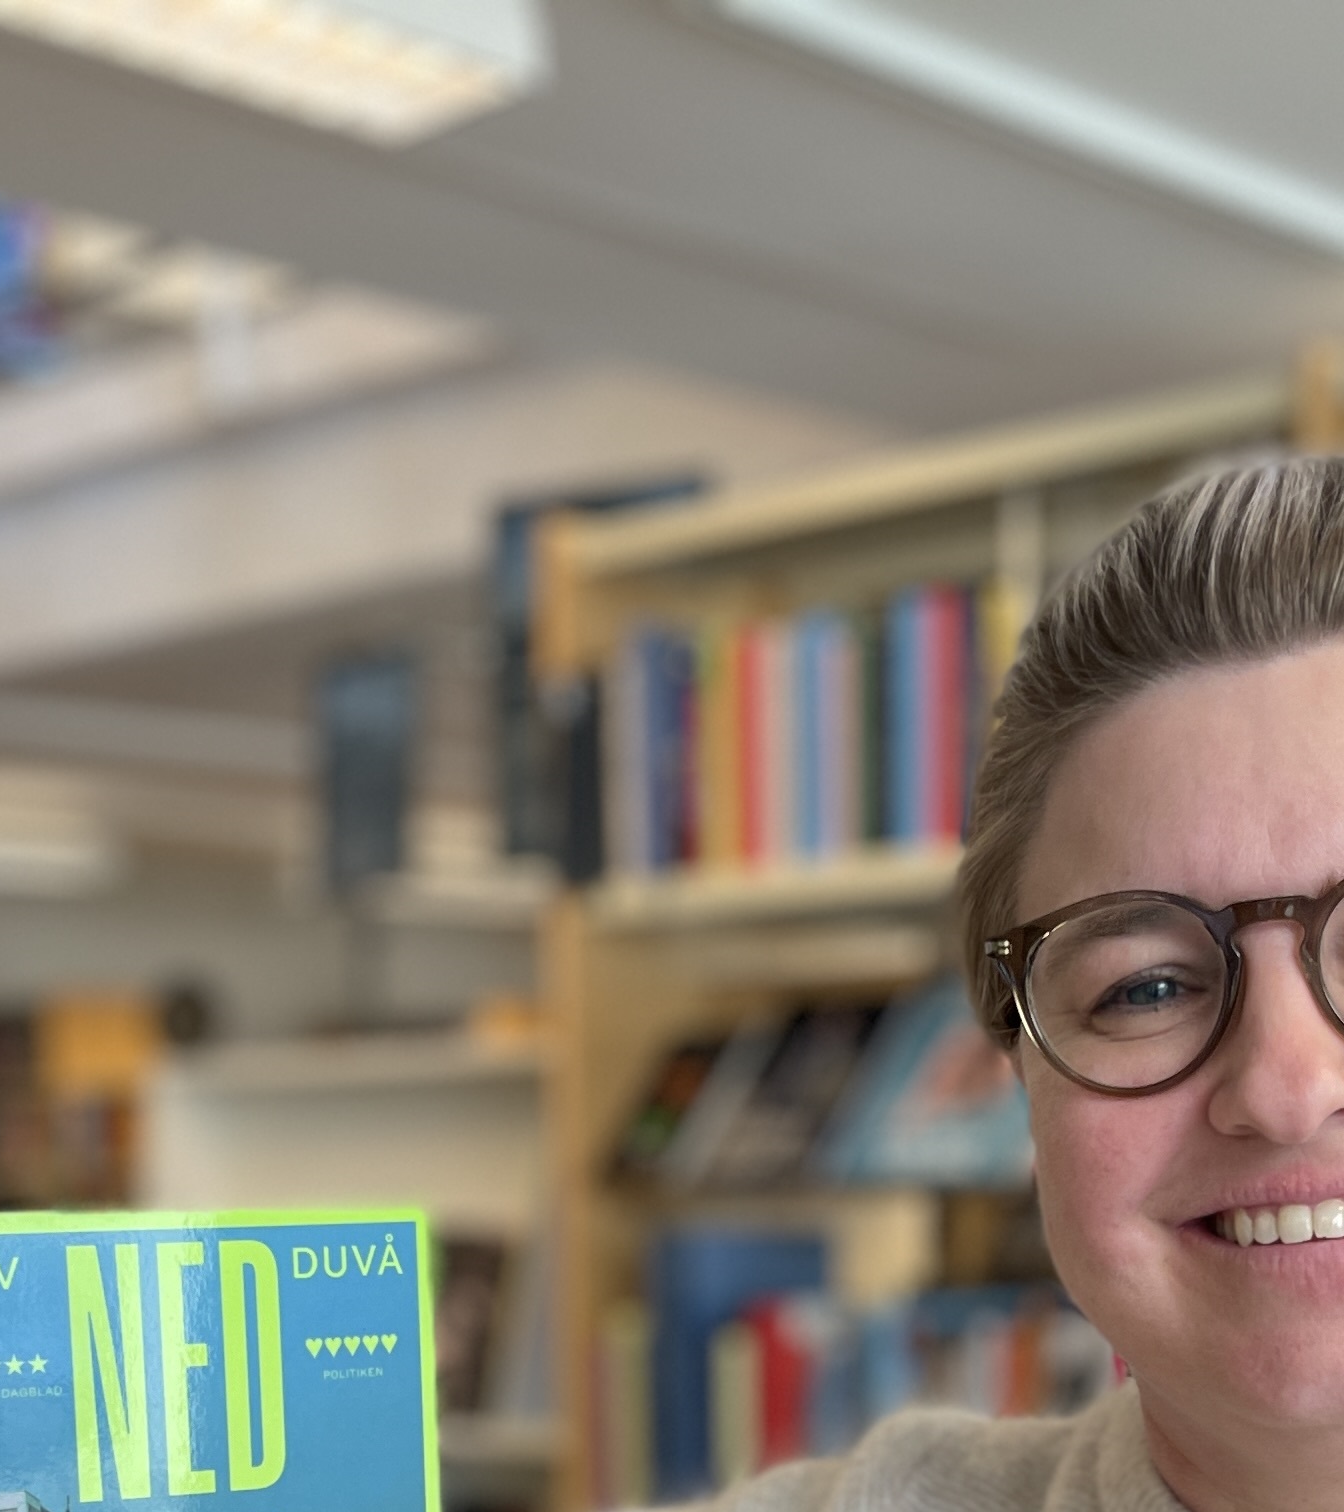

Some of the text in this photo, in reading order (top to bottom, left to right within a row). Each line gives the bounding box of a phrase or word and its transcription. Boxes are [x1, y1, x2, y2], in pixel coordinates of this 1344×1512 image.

[292, 1233, 404, 1279] DUVÅ
[66, 1239, 287, 1503] NED
[323, 1367, 384, 1380] POLITIKEN
[1, 1385, 63, 1399] DAGBLAD
